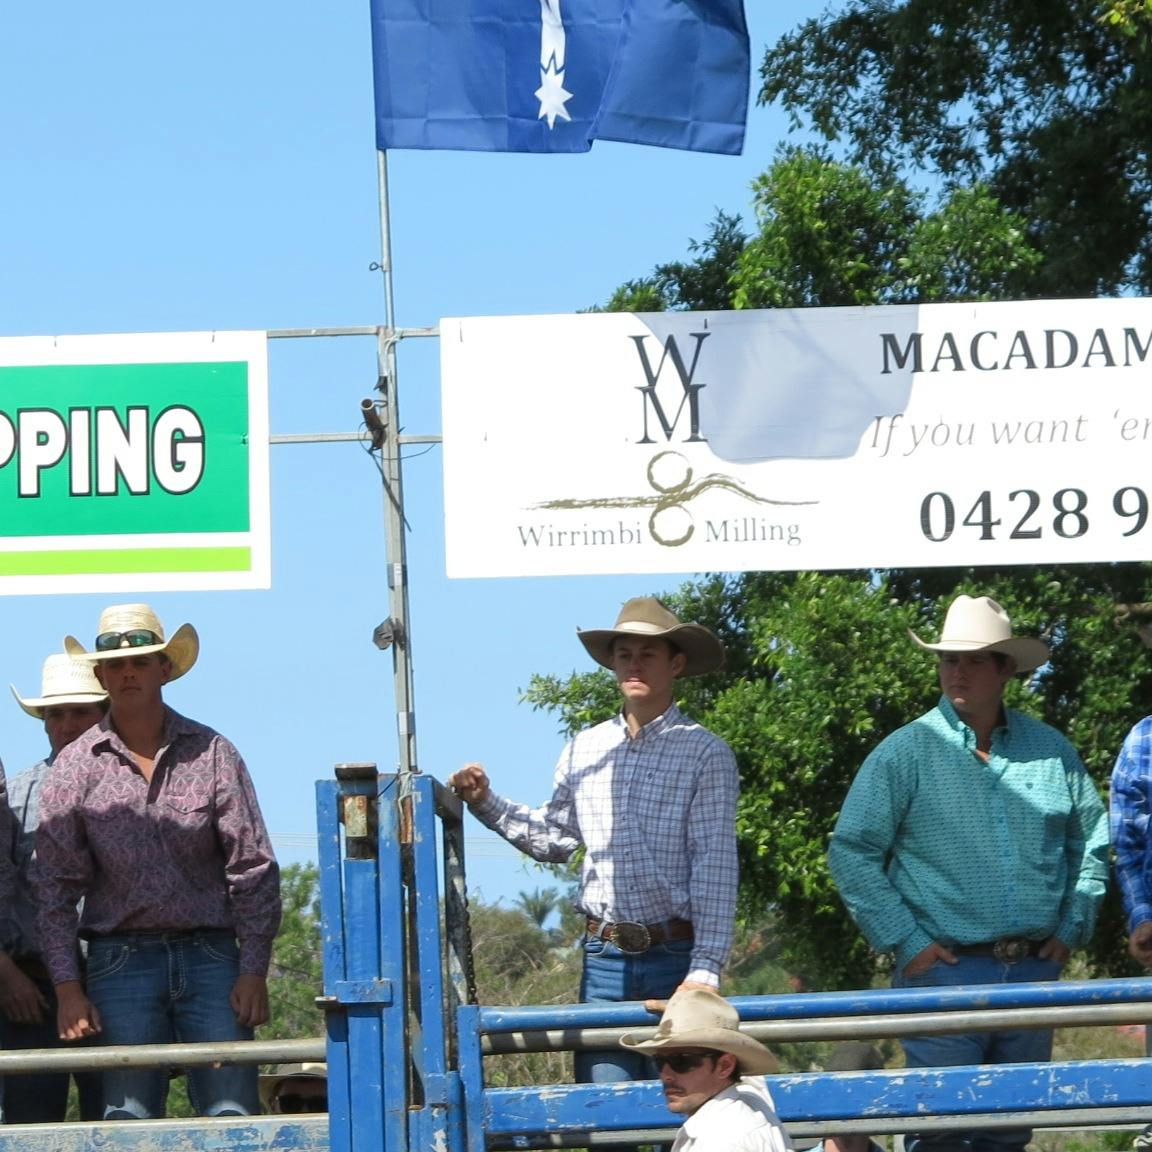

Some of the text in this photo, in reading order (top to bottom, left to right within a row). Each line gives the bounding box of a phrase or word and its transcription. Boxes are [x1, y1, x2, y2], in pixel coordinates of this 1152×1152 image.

[870, 413, 905, 457] If
[903, 420, 976, 457] you
[990, 413, 1089, 446] want
[516, 517, 802, 548] Wirrimbi Milling
[919, 486, 1149, 543] 0428 9
